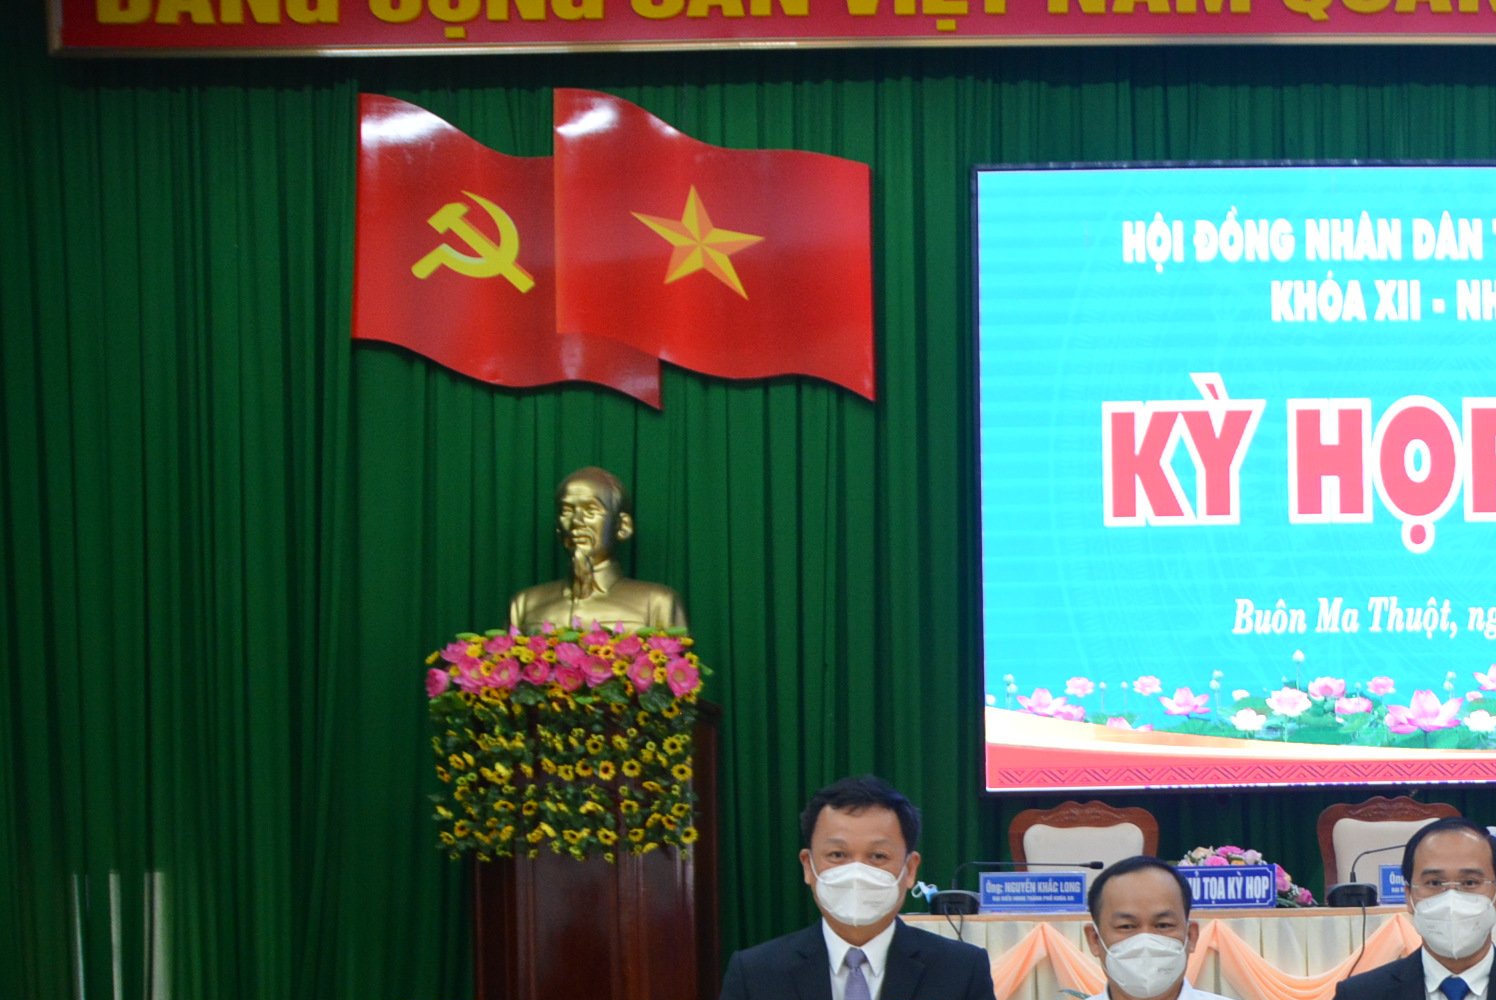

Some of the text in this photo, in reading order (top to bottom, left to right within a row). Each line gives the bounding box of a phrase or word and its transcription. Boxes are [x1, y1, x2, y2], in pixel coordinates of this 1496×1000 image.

[1122, 212, 1185, 272] HỘI
[1193, 206, 1296, 263] ĐỒNG
[1305, 210, 1402, 261] NHÂN
[1412, 210, 1484, 261] DÂN
[1270, 270, 1367, 323] KHÓA
[1374, 279, 1422, 322] XII
[1102, 372, 1267, 528] KỲ
[1232, 598, 1307, 635] Buôn
[1315, 597, 1360, 633] Ma
[1367, 596, 1458, 640] Thuột,
[1202, 876, 1225, 904] TỌA
[1227, 871, 1245, 899] KỲ
[1246, 876, 1269, 904] HỌP
